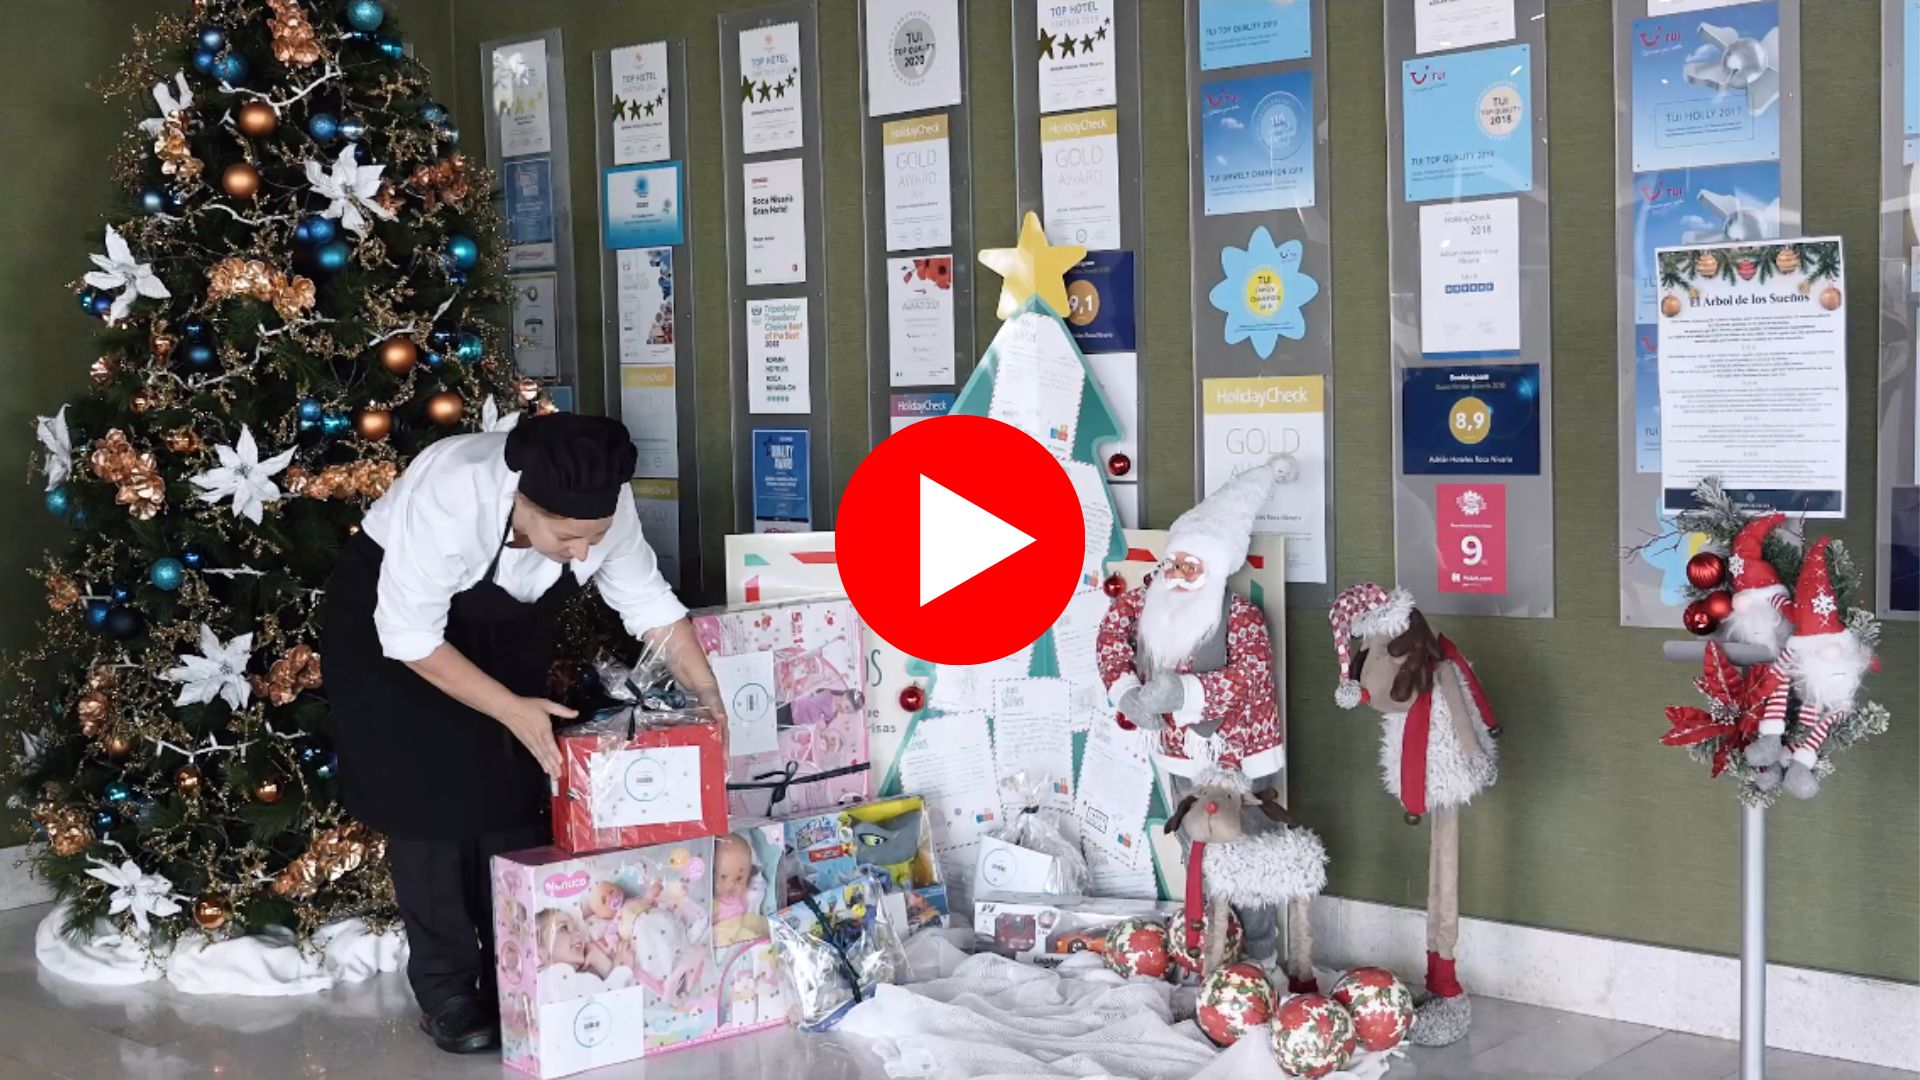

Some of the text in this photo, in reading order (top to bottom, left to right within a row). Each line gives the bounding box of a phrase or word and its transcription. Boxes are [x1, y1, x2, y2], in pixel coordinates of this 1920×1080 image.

[906, 32, 923, 45] TUI
[904, 55, 924, 67] 2020
[1492, 96, 1509, 106] TUI
[1490, 114, 1512, 126] 2018
[896, 150, 937, 169] GOLD
[1055, 146, 1104, 168] GOLD
[1070, 295, 1093, 314] 9,1
[1689, 291, 1810, 308] El Árbol de los Sueños
[897, 400, 947, 414] HolidayCheck
[1216, 387, 1309, 409] HolidayCheck
[1455, 411, 1486, 433] 8,9
[1226, 428, 1301, 455] GOLD
[1461, 535, 1484, 566] 9
